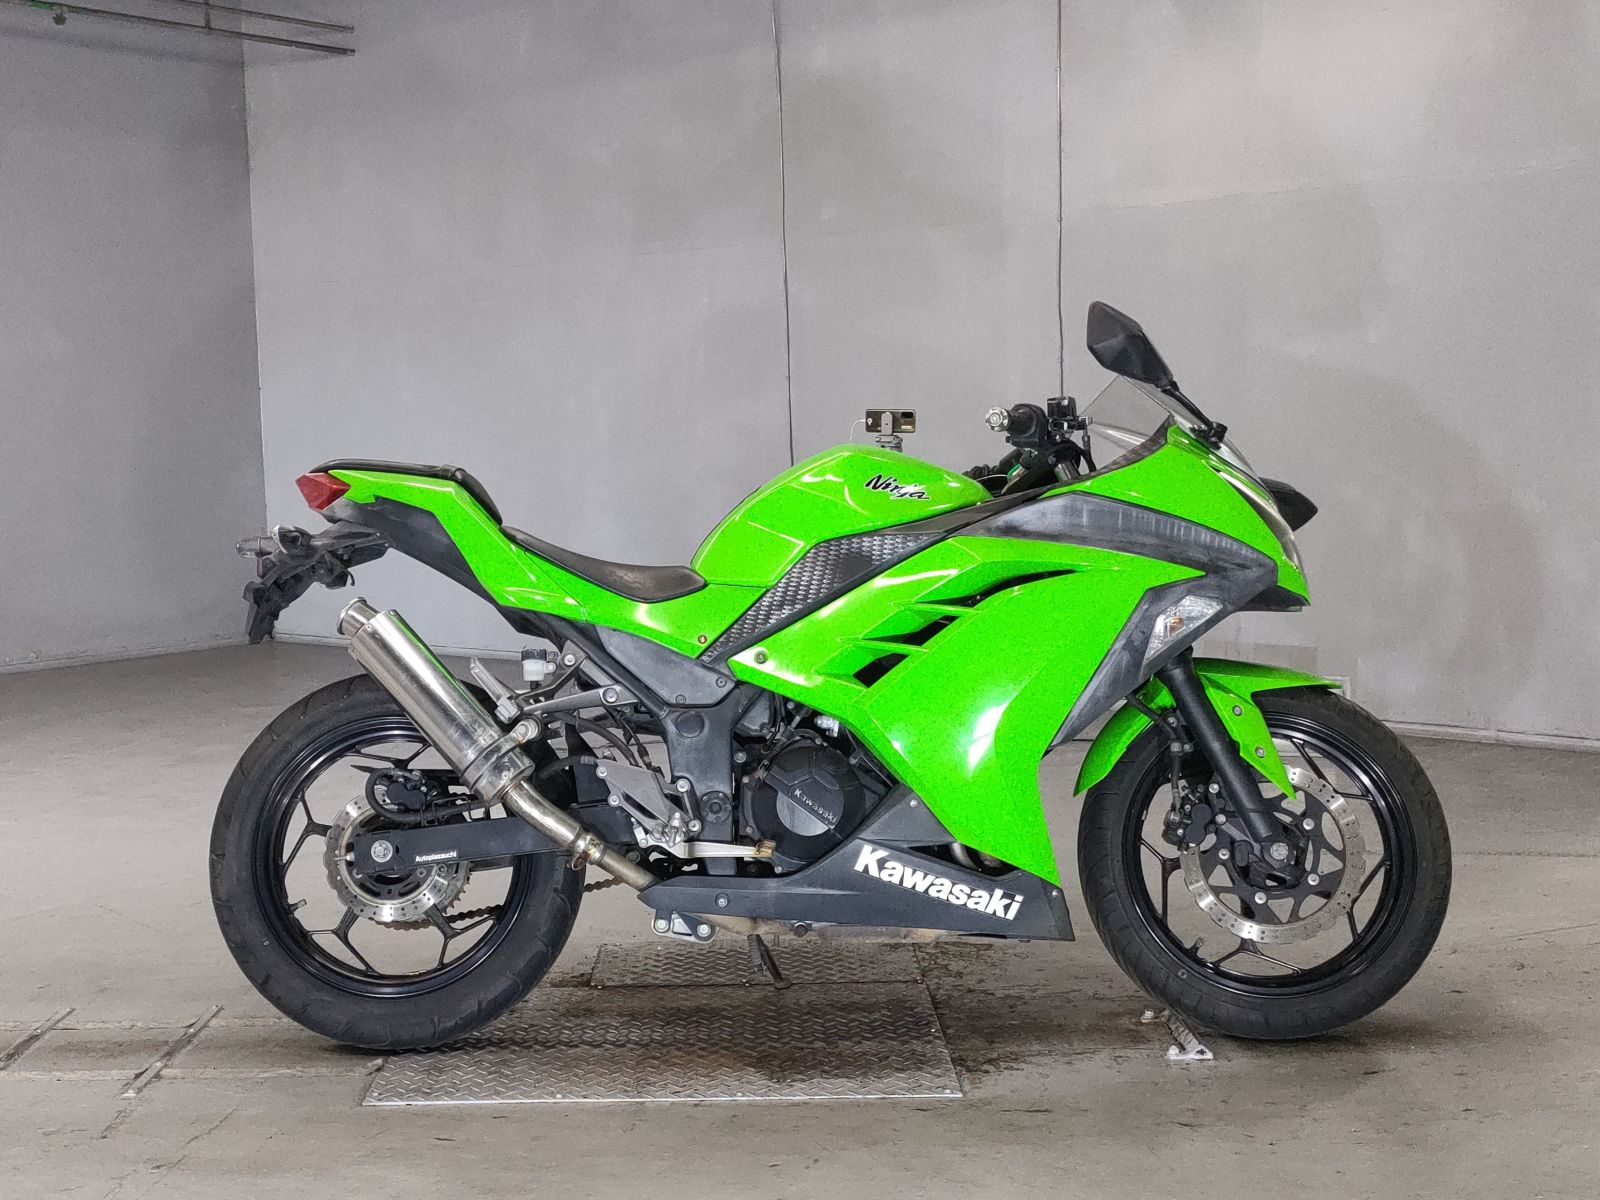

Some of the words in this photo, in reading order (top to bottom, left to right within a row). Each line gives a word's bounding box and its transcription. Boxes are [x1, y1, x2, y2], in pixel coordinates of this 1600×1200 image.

[864, 474, 931, 500] Ninja
[794, 788, 838, 823] Kawasaki
[853, 844, 1024, 921] Kawasaki
